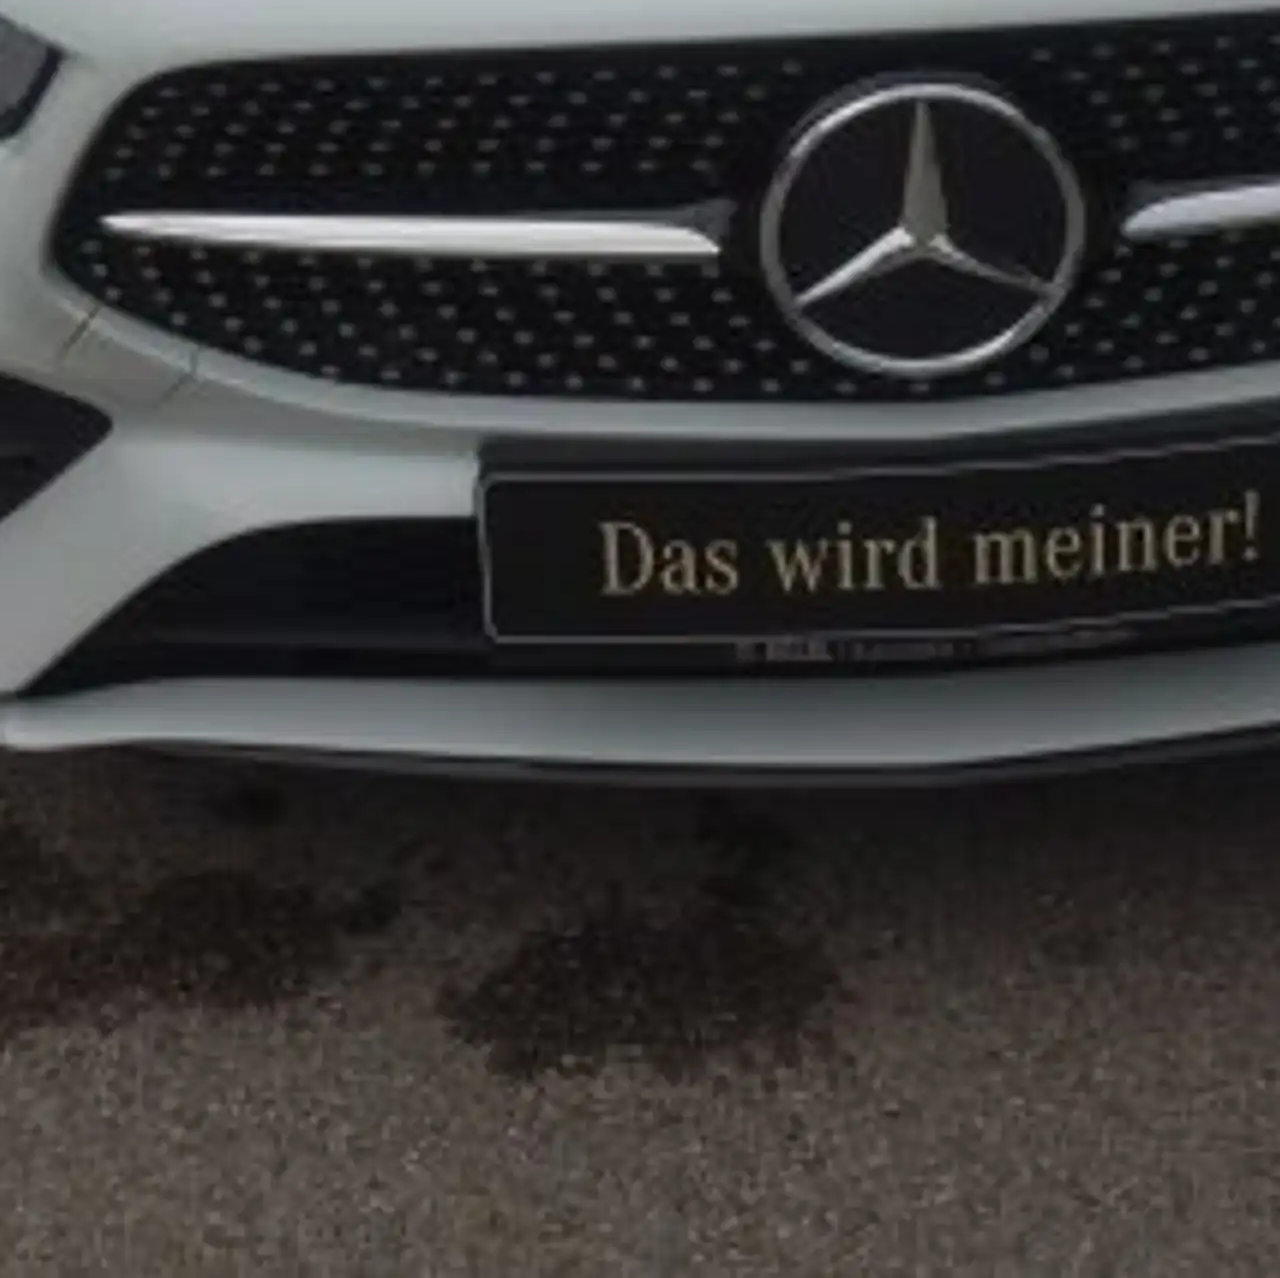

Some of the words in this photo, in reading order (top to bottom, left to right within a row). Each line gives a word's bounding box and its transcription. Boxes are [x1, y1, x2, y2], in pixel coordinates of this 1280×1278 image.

[600, 520, 739, 597] Das
[765, 517, 943, 592] wird
[972, 489, 1262, 586] meiner!
